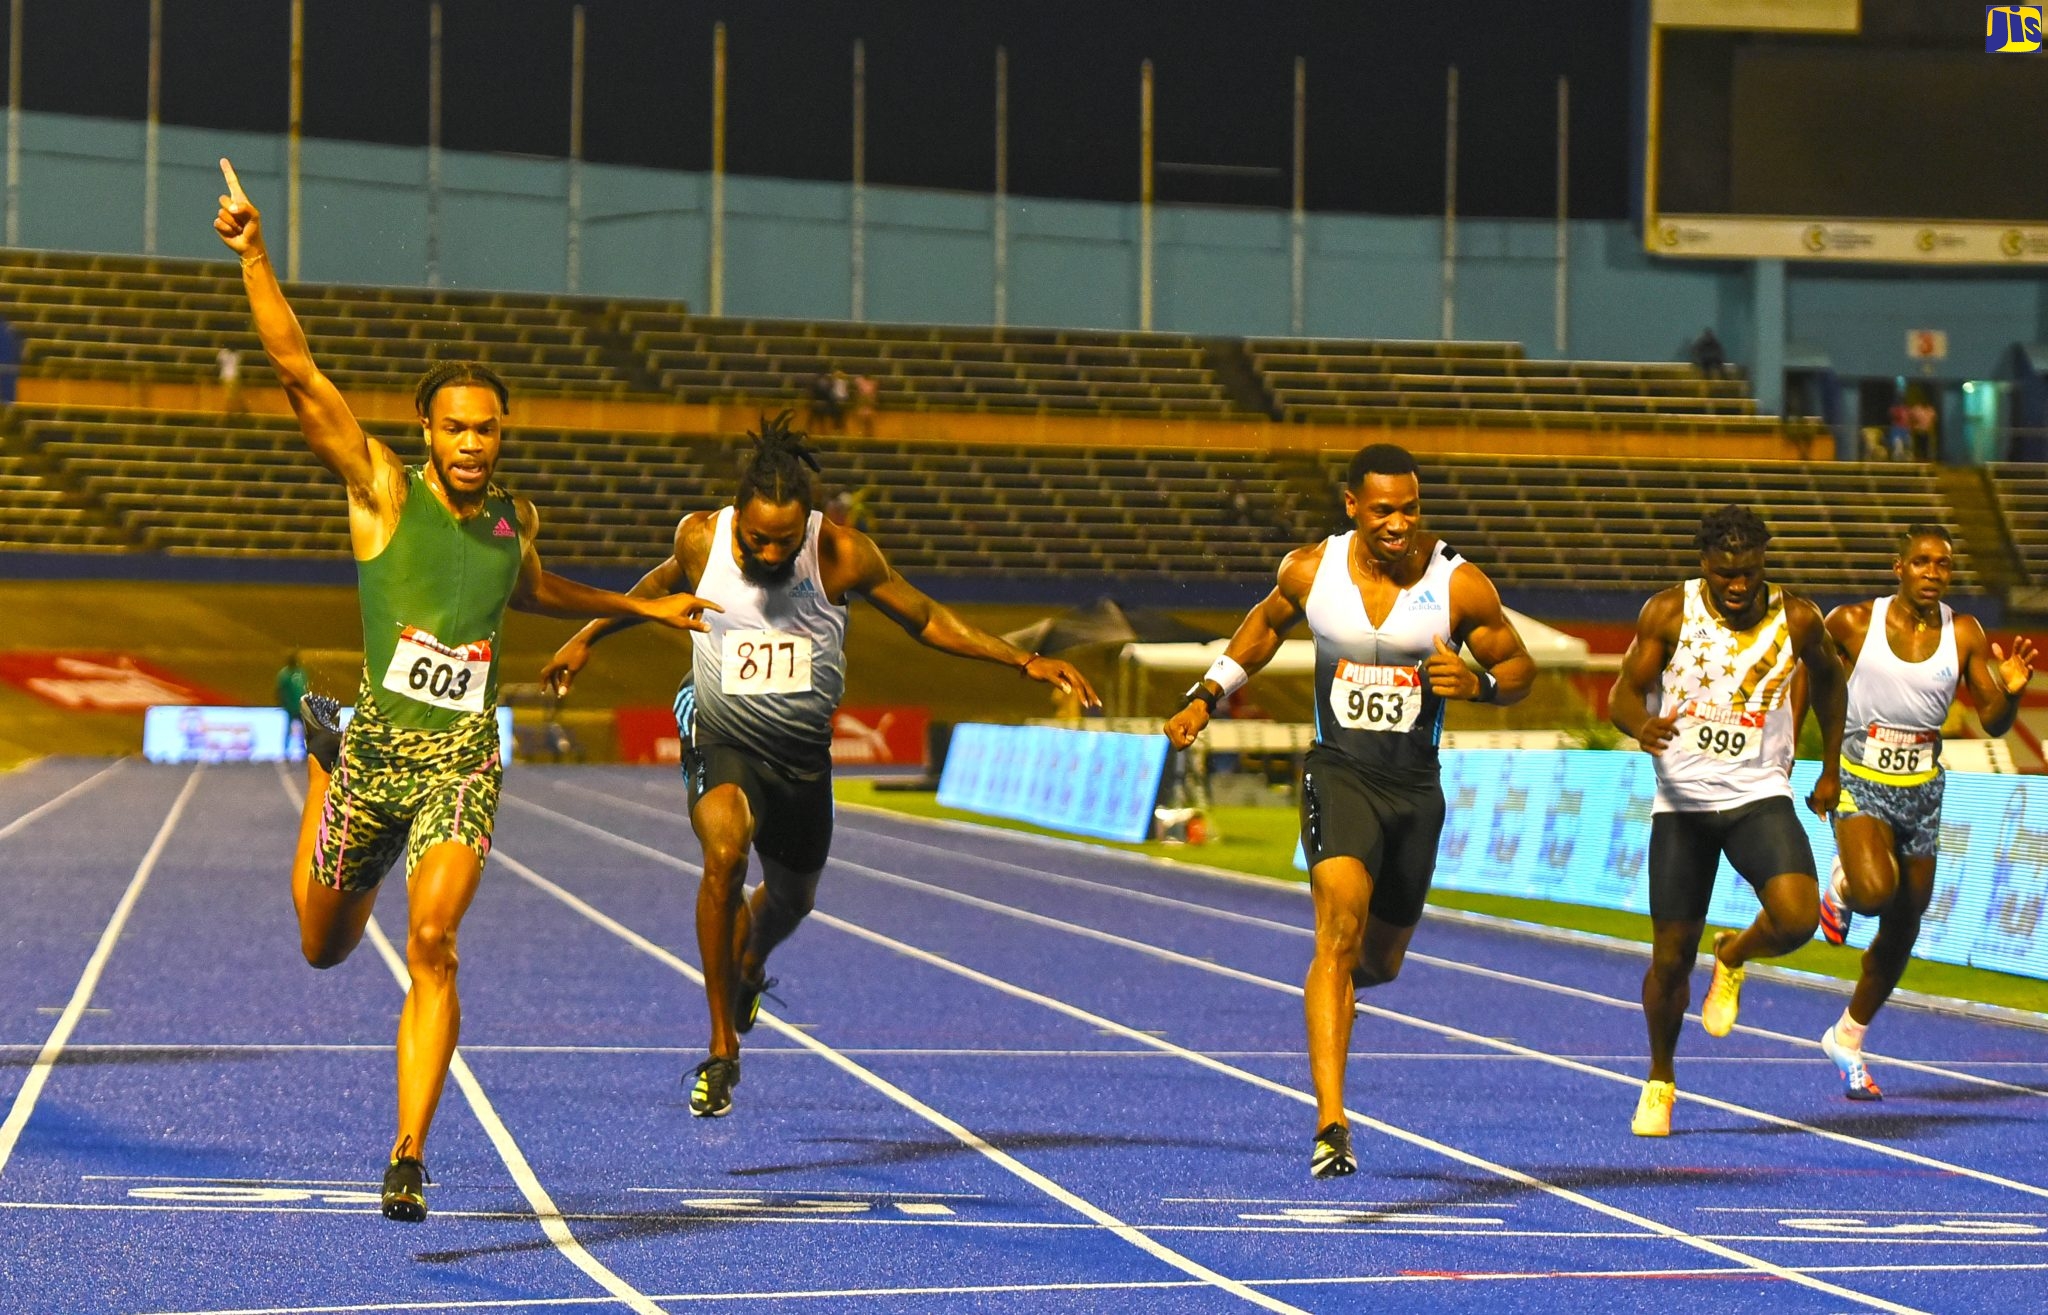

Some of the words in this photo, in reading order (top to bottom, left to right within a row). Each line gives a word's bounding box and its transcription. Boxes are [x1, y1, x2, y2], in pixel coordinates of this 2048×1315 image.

[737, 642, 795, 681] 877
[1342, 661, 1395, 686] PUMA
[408, 656, 472, 701] 603
[1347, 690, 1404, 724] 963
[1697, 725, 1746, 757] 999
[1878, 747, 1920, 772] 856
